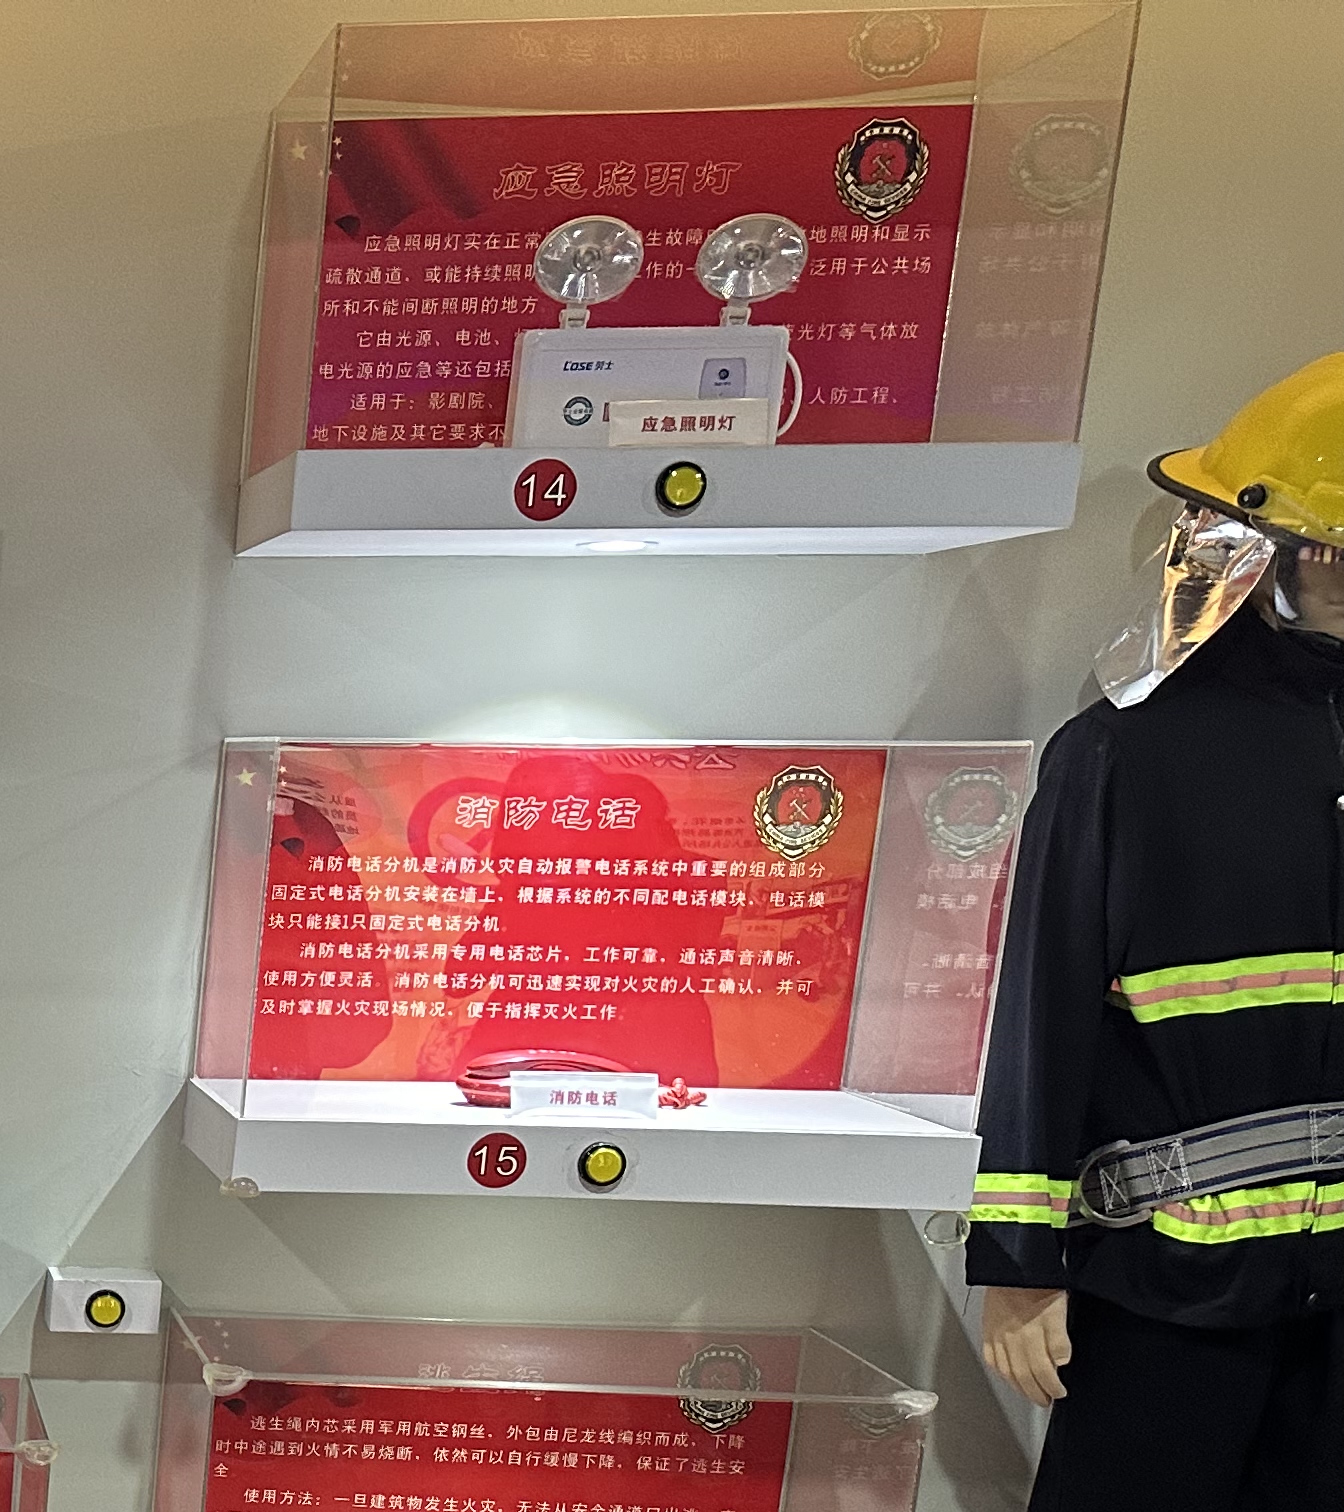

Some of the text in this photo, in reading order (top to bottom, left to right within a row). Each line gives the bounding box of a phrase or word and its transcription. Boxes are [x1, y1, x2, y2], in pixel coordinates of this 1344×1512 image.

[493, 161, 742, 199] 应急照明灯
[642, 416, 736, 432] 应急照明灯
[521, 473, 568, 506] 14
[455, 795, 641, 830] 消防电话
[549, 1088, 619, 1107] 消防电话
[473, 1145, 519, 1176] 15
